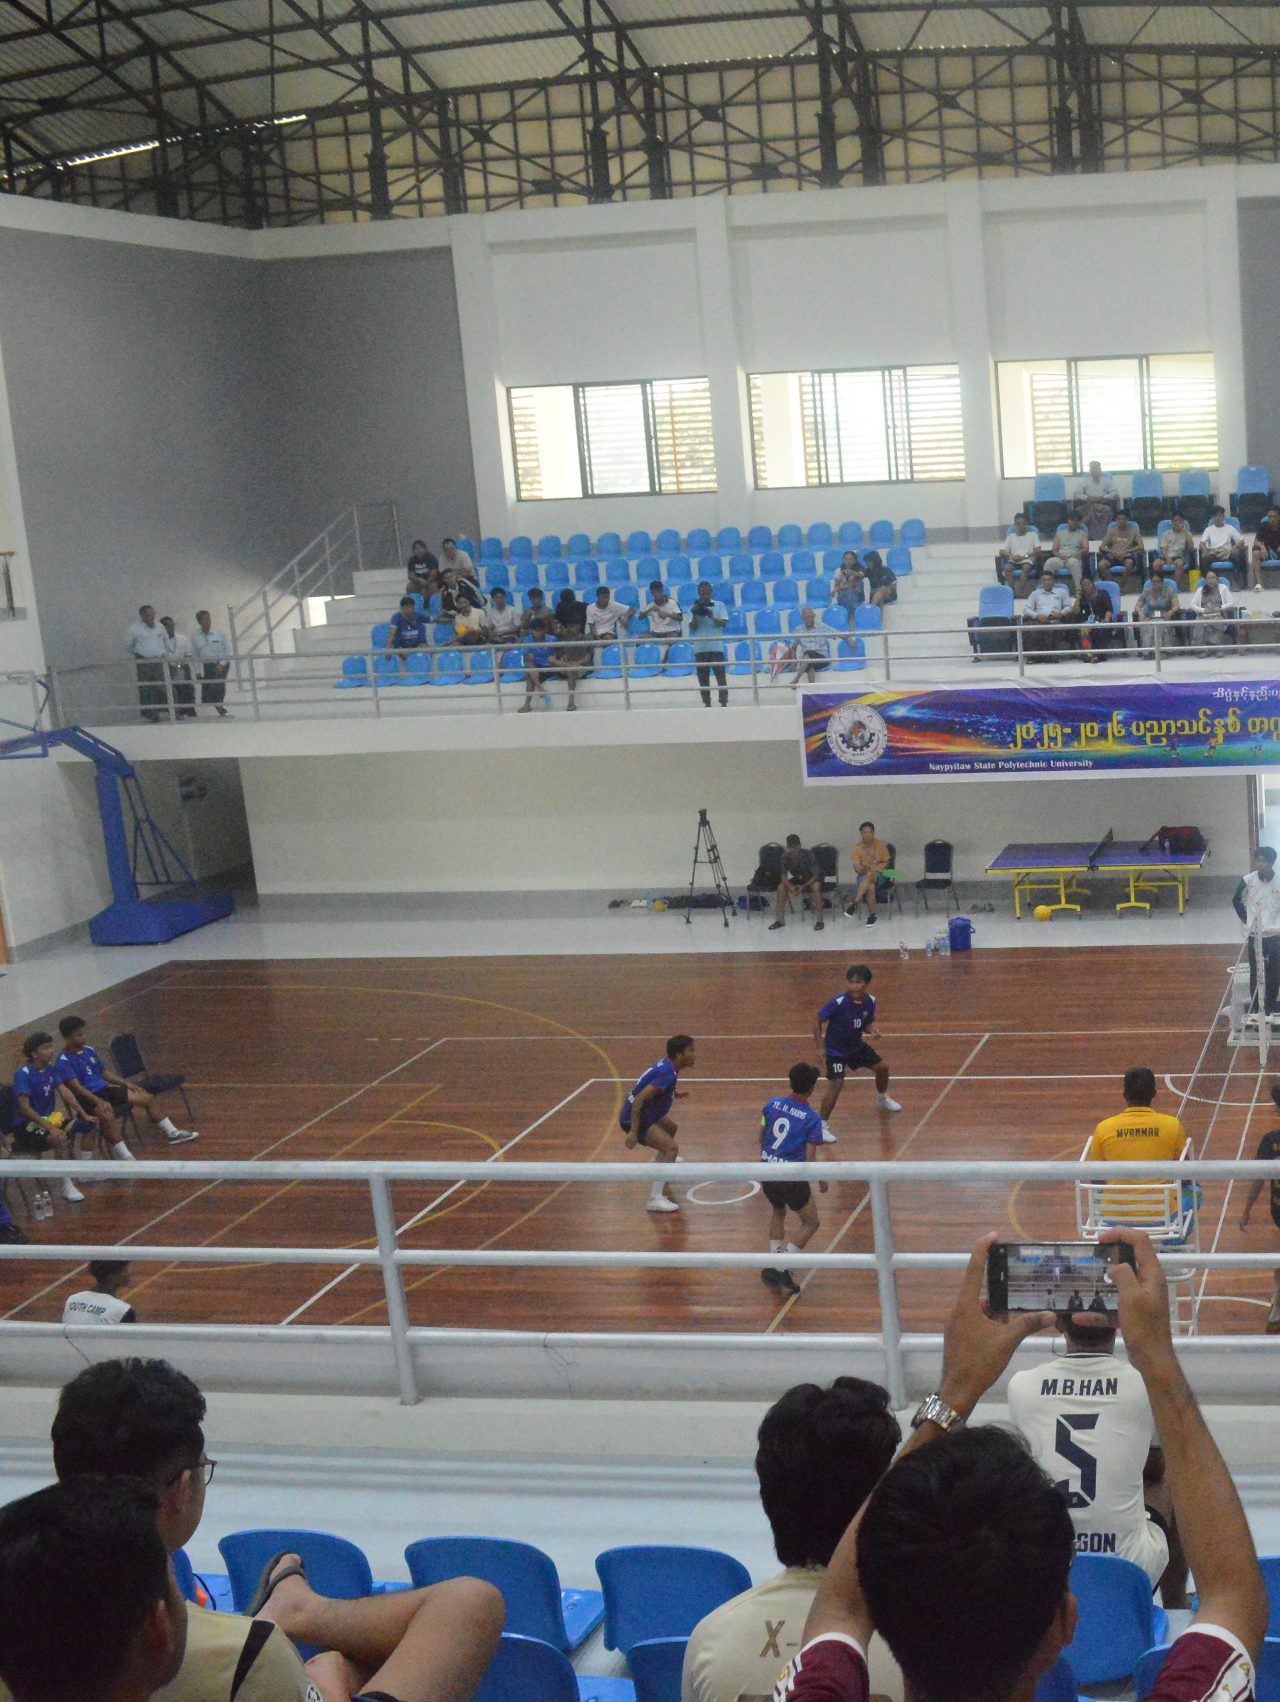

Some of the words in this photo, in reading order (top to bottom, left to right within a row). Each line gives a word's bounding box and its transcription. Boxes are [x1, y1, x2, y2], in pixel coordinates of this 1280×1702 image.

[1131, 706, 1243, 747] ပညာသင်နှစ်
[929, 762, 971, 772] Naypyitaw
[973, 761, 996, 770] State
[998, 760, 1048, 770] Polytechnic
[1050, 758, 1094, 769] University
[853, 1018, 861, 1029] 10
[832, 1062, 843, 1073] 10
[772, 1117, 790, 1150] 9
[1116, 1127, 1160, 1139] MYANMAR
[1040, 1378, 1118, 1397] M.B.HAN
[1054, 1412, 1100, 1509] 5
[1075, 1532, 1117, 1553] GON
